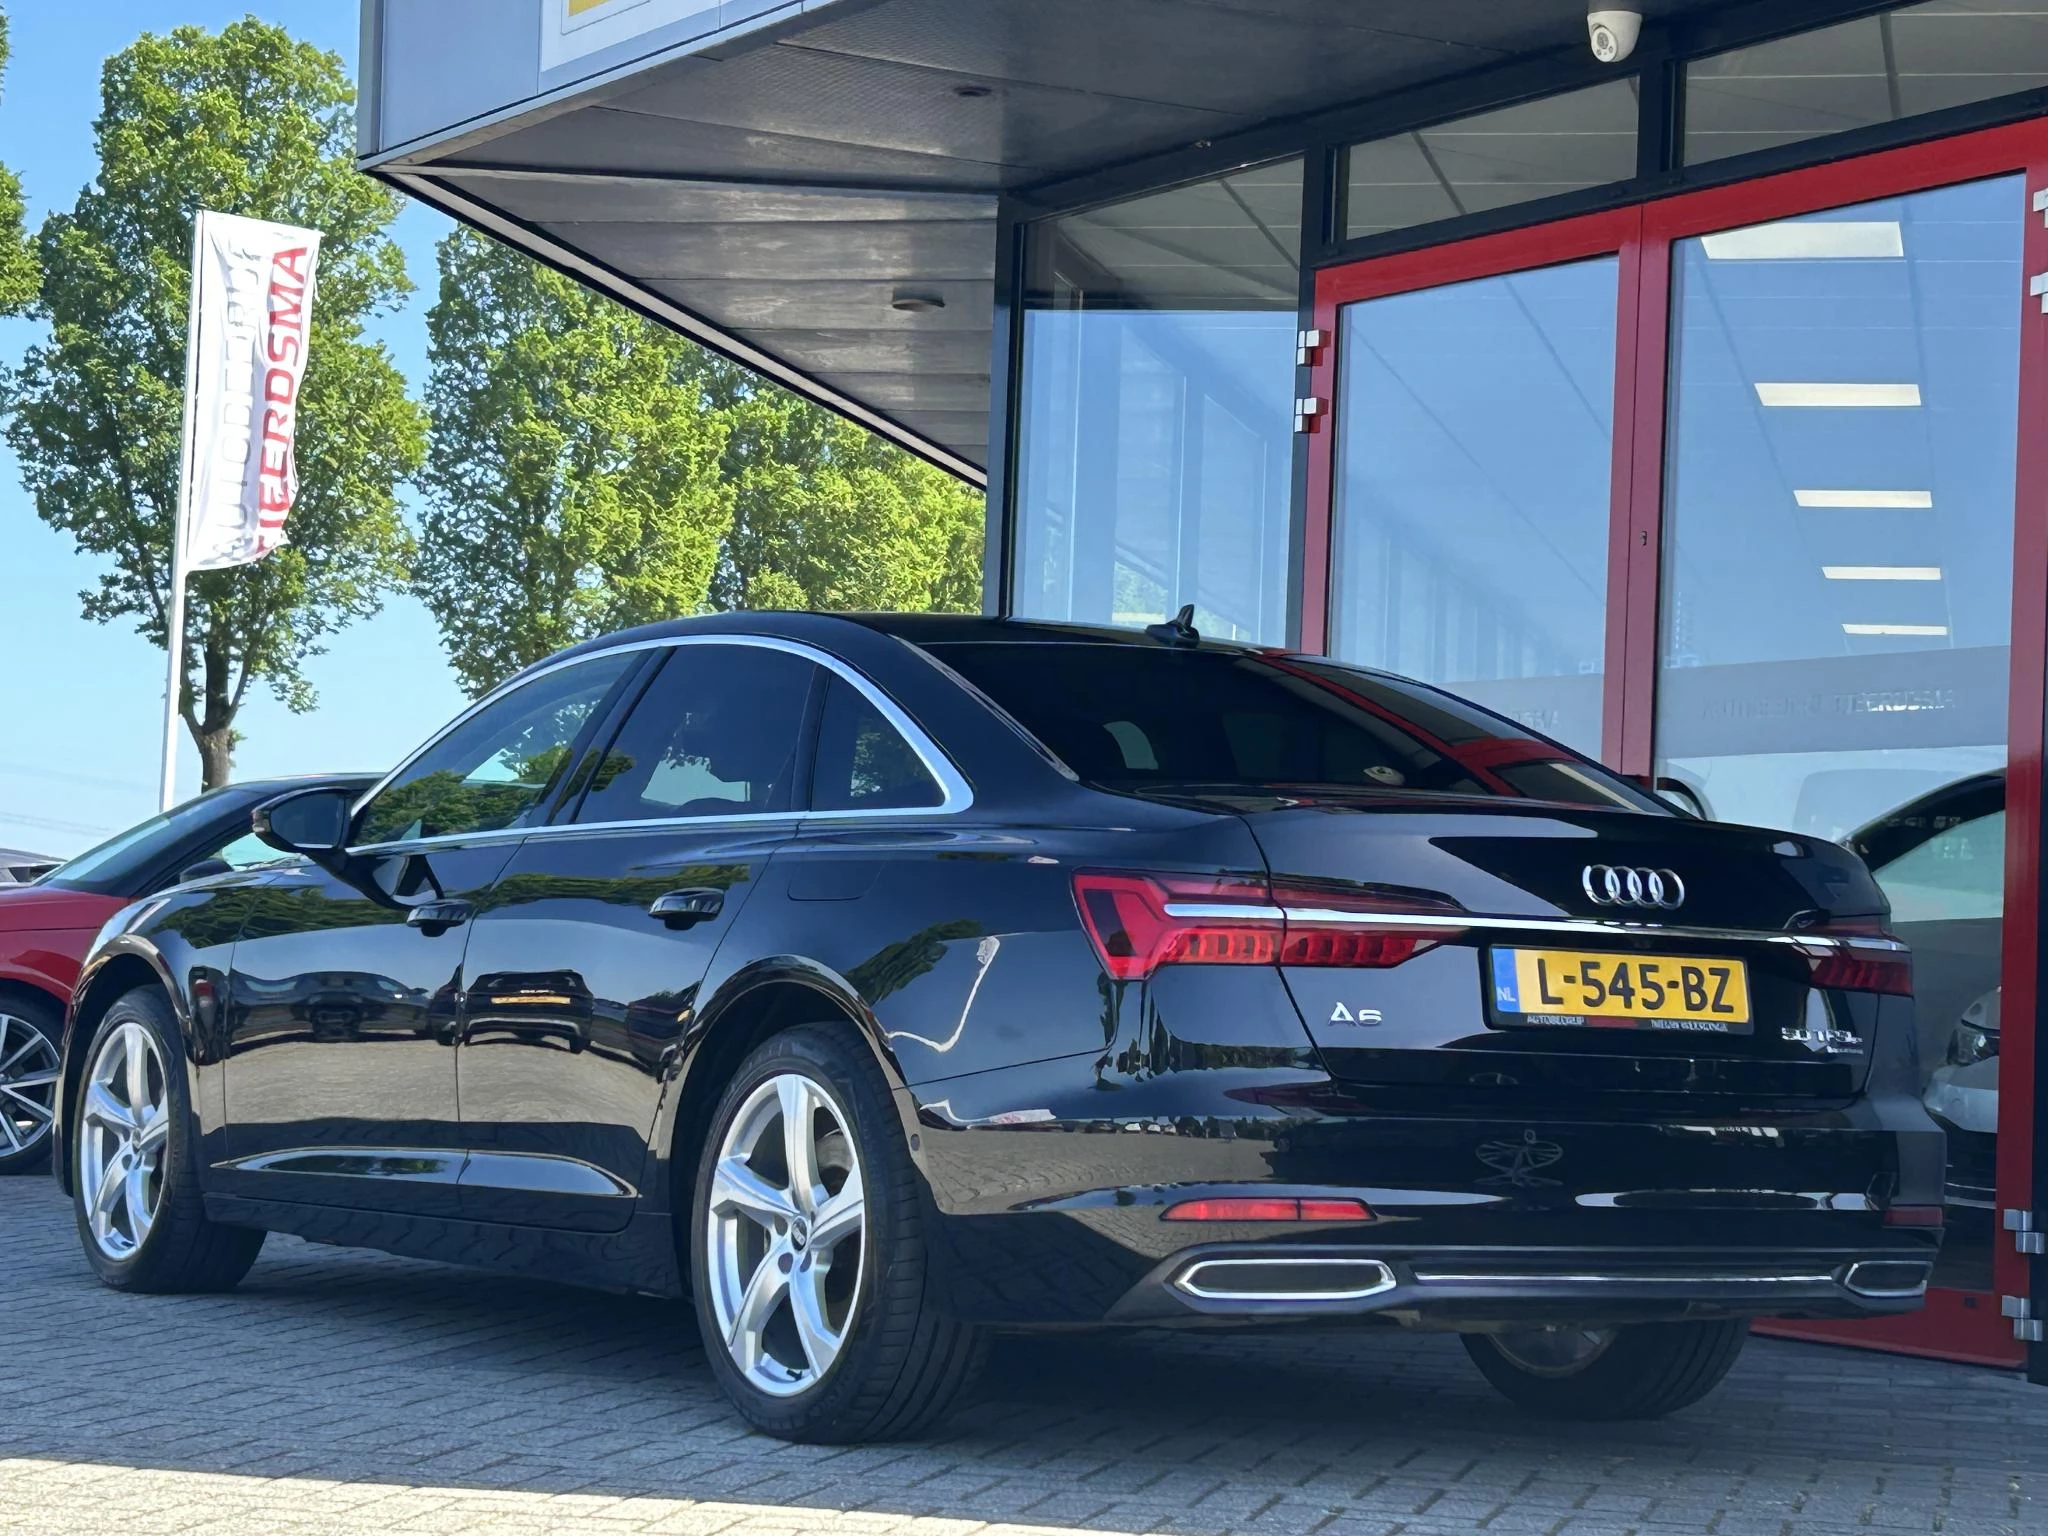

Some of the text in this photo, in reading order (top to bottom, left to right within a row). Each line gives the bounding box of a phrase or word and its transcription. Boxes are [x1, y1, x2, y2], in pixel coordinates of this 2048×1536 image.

[1496, 986, 1516, 1002] NL
[1536, 958, 1734, 1013] L-545-BZ
[1328, 1001, 1382, 1025] A6
